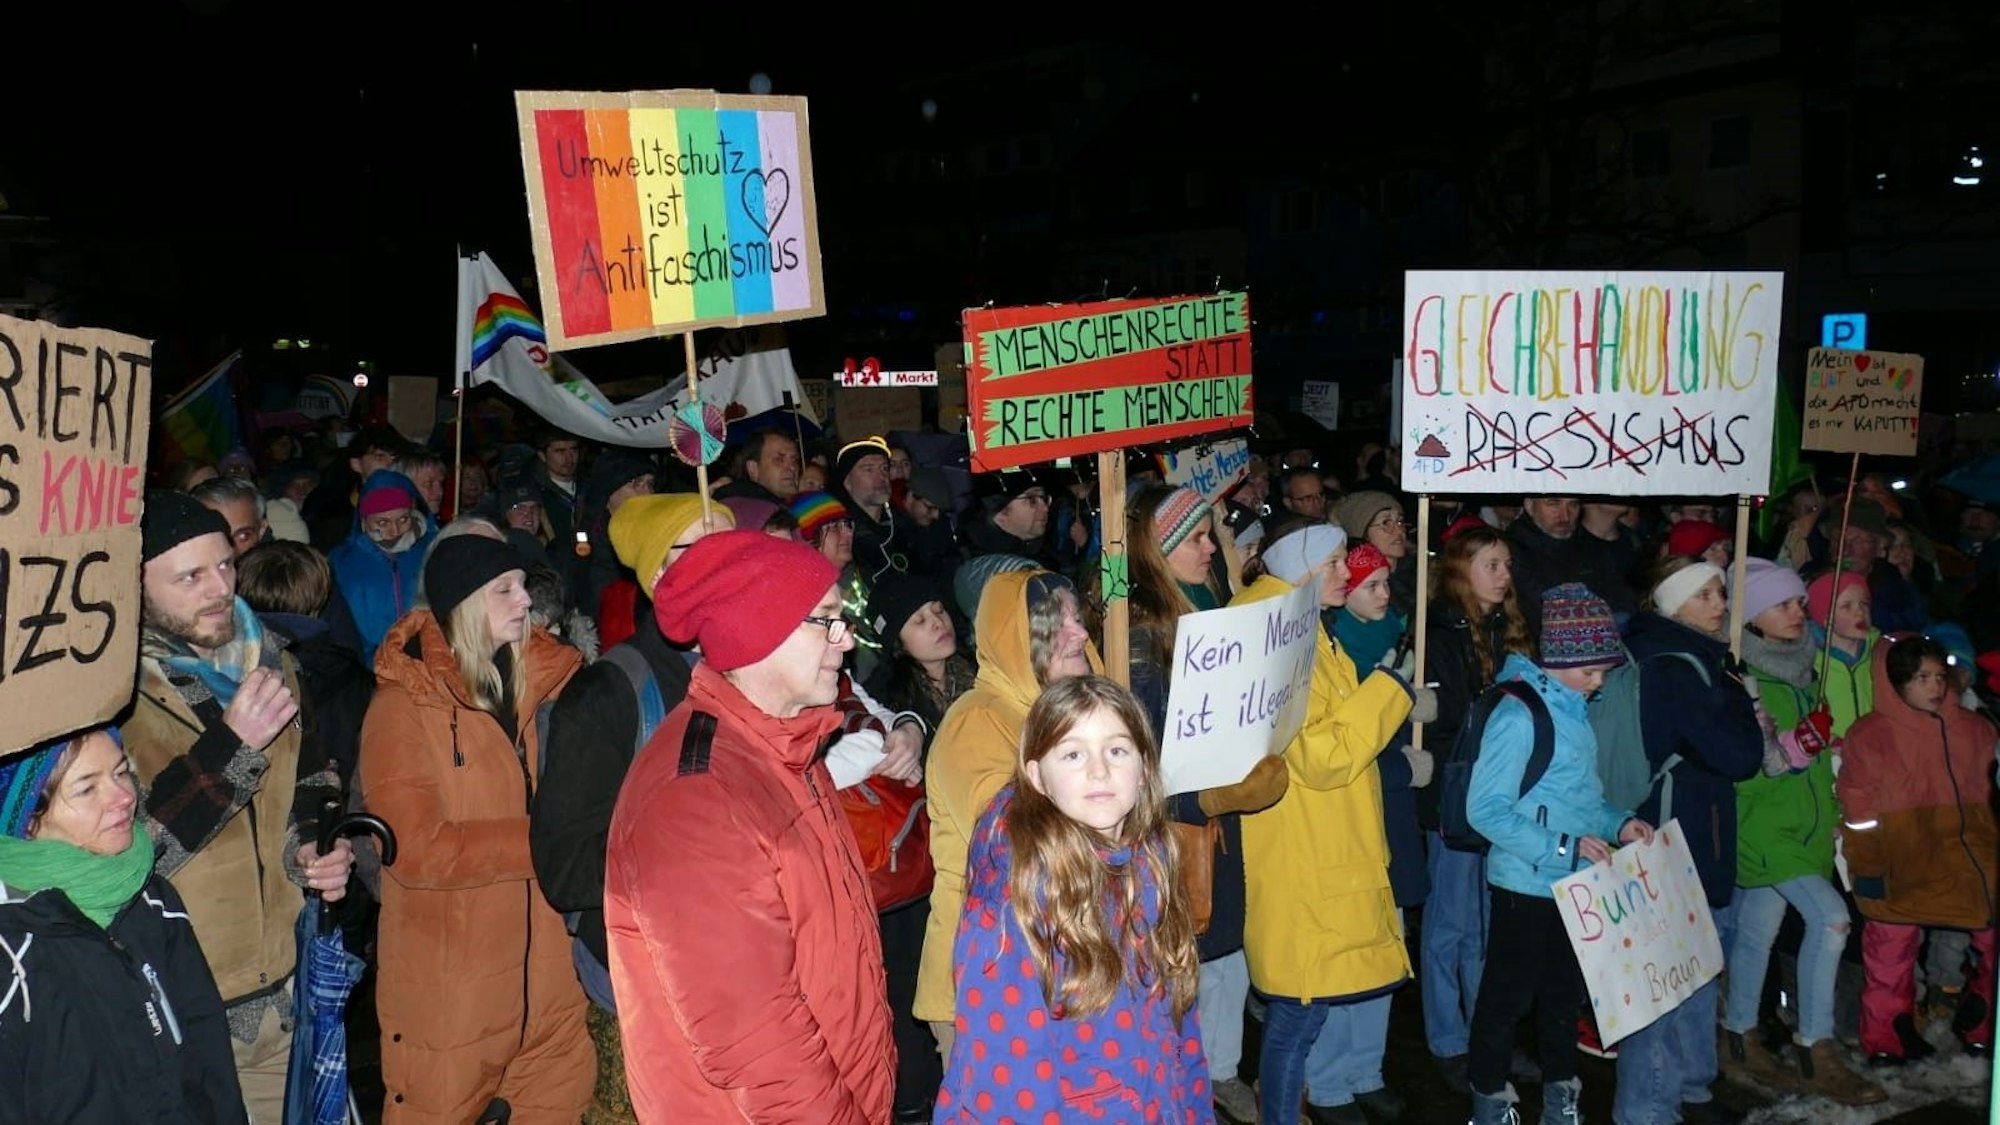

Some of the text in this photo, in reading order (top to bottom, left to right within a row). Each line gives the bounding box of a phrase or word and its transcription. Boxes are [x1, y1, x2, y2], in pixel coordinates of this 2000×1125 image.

[557, 130, 748, 179] Umweltschutz
[648, 184, 682, 228] ist
[574, 224, 799, 299] Antifaschismus
[994, 297, 1237, 376] MENSCHENRECHTE
[1408, 281, 1764, 401] GLEICHBEHANDLUNG
[1833, 321, 1855, 348] P
[895, 372, 935, 383] Markt
[1165, 338, 1243, 381] STATT
[1811, 350, 1853, 369] Mein
[1856, 375, 1882, 388] und
[1001, 391, 1106, 447] RECHTE
[1123, 377, 1240, 428] MENSCHEN
[1808, 394, 1829, 409] die
[1808, 418, 1821, 430] es
[1465, 410, 1750, 472] RASSISMUS
[39, 450, 140, 535] KNIE
[1183, 591, 1320, 678] Kein Mensch
[1176, 692, 1214, 740] ist
[1568, 851, 1660, 942] Bunt
[1643, 955, 1702, 1003] Braun
